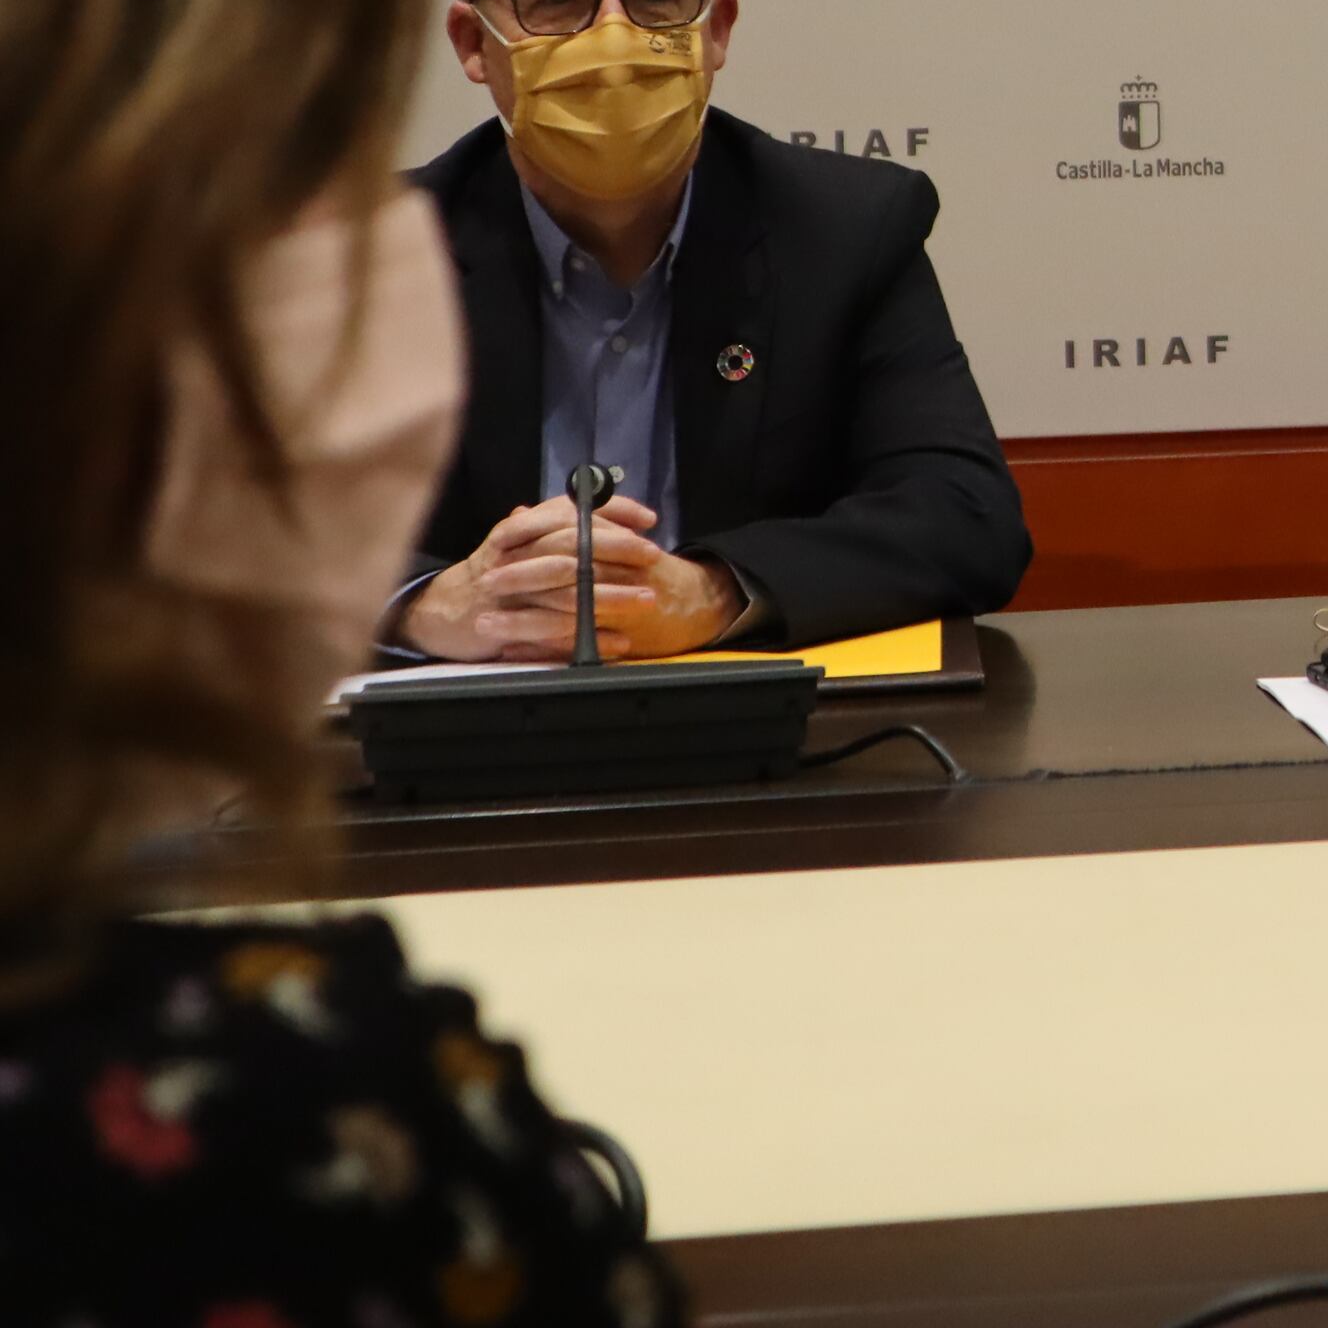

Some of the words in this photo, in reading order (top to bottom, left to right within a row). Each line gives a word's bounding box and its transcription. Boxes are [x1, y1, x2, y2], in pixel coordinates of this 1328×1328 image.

[790, 128, 929, 158] RIAF
[1056, 160, 1153, 179] Castilla-La
[1157, 158, 1224, 177] Mancha
[1065, 335, 1228, 368] IRIAF
